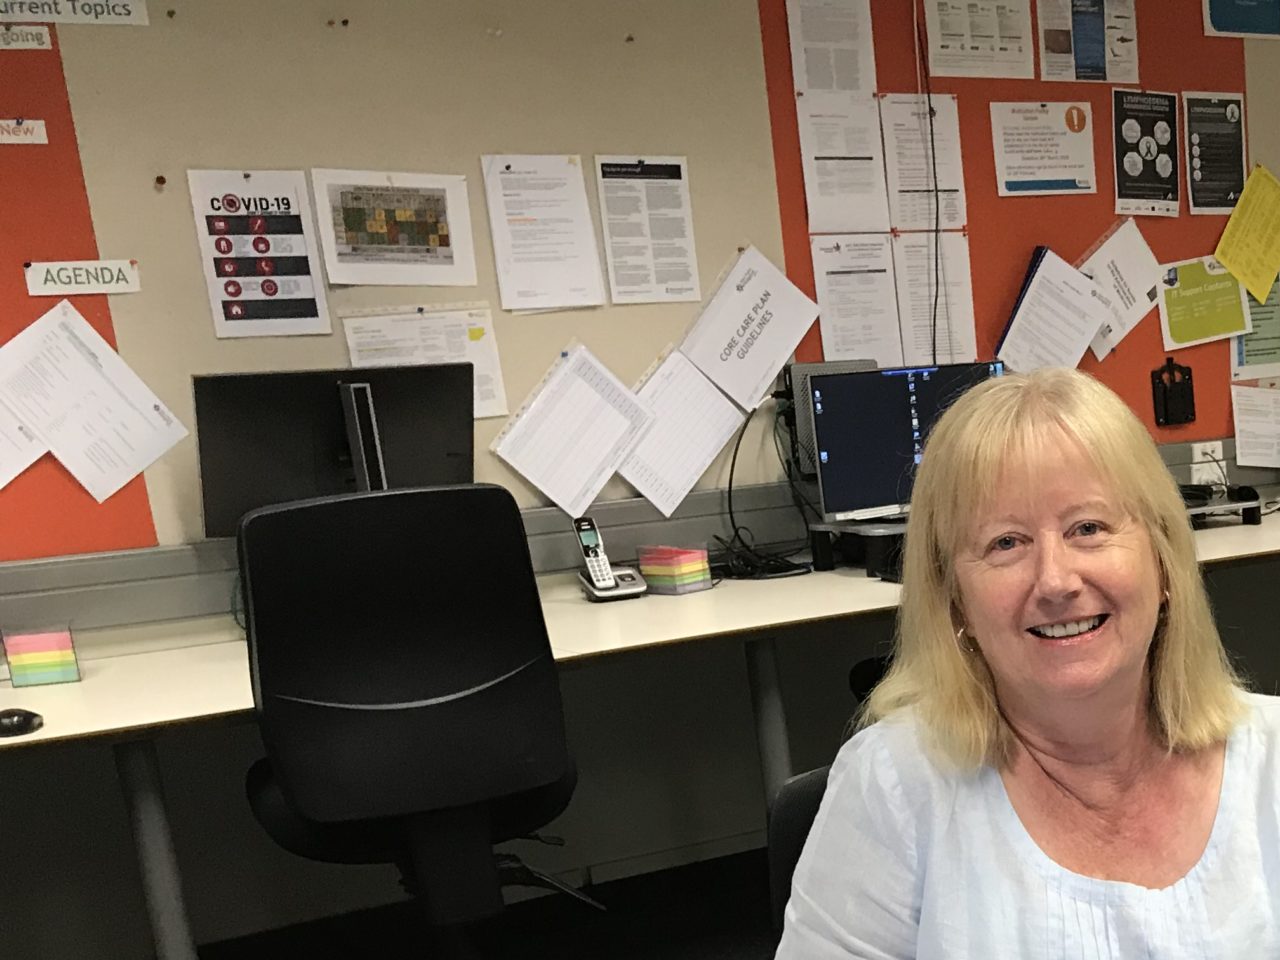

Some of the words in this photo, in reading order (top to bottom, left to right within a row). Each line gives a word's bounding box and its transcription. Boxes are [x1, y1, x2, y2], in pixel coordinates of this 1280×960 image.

[0, 0, 62, 15] urrent
[66, 0, 132, 19] Topics
[0, 31, 45, 46] going
[210, 194, 291, 213] COVID-19
[43, 267, 129, 285] AGENDA
[720, 336, 739, 362] CORE
[736, 313, 755, 339] CARE
[752, 290, 772, 315] PLAN
[736, 310, 774, 360] GUIDELINES
